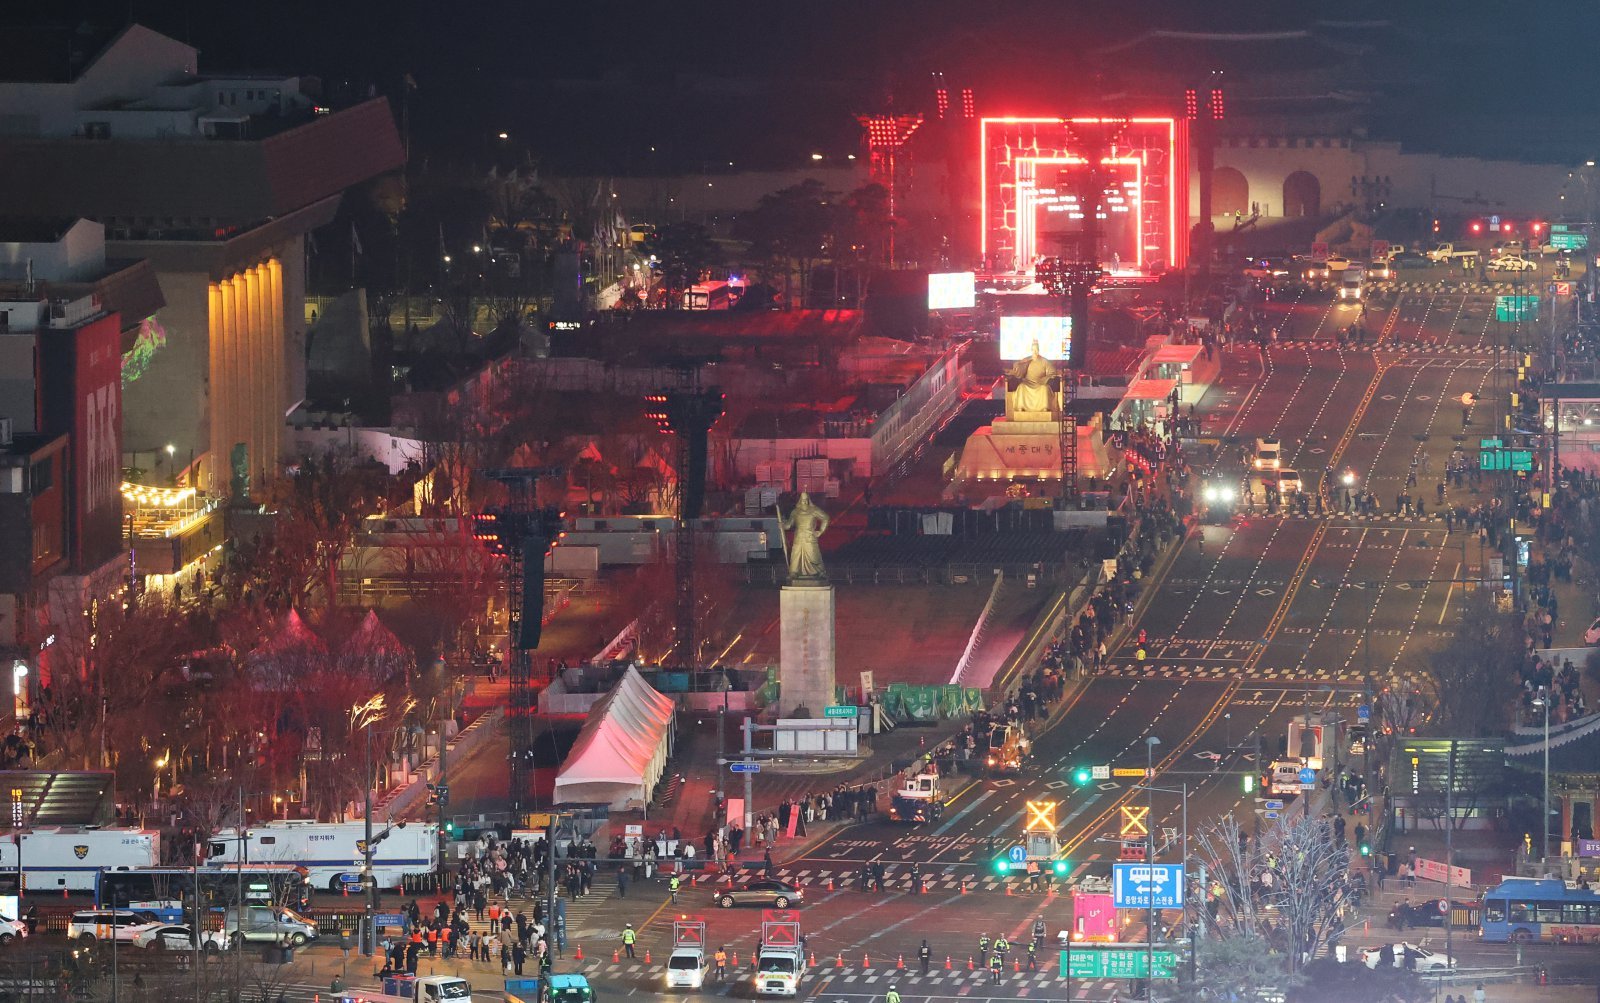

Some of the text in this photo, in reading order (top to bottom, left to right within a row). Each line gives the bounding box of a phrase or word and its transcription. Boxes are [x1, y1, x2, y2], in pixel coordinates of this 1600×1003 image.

[1005, 444, 1053, 455] 세종대왕
[1125, 895, 1174, 905] 중앙차로스전용
[1089, 908, 1101, 918] U+
